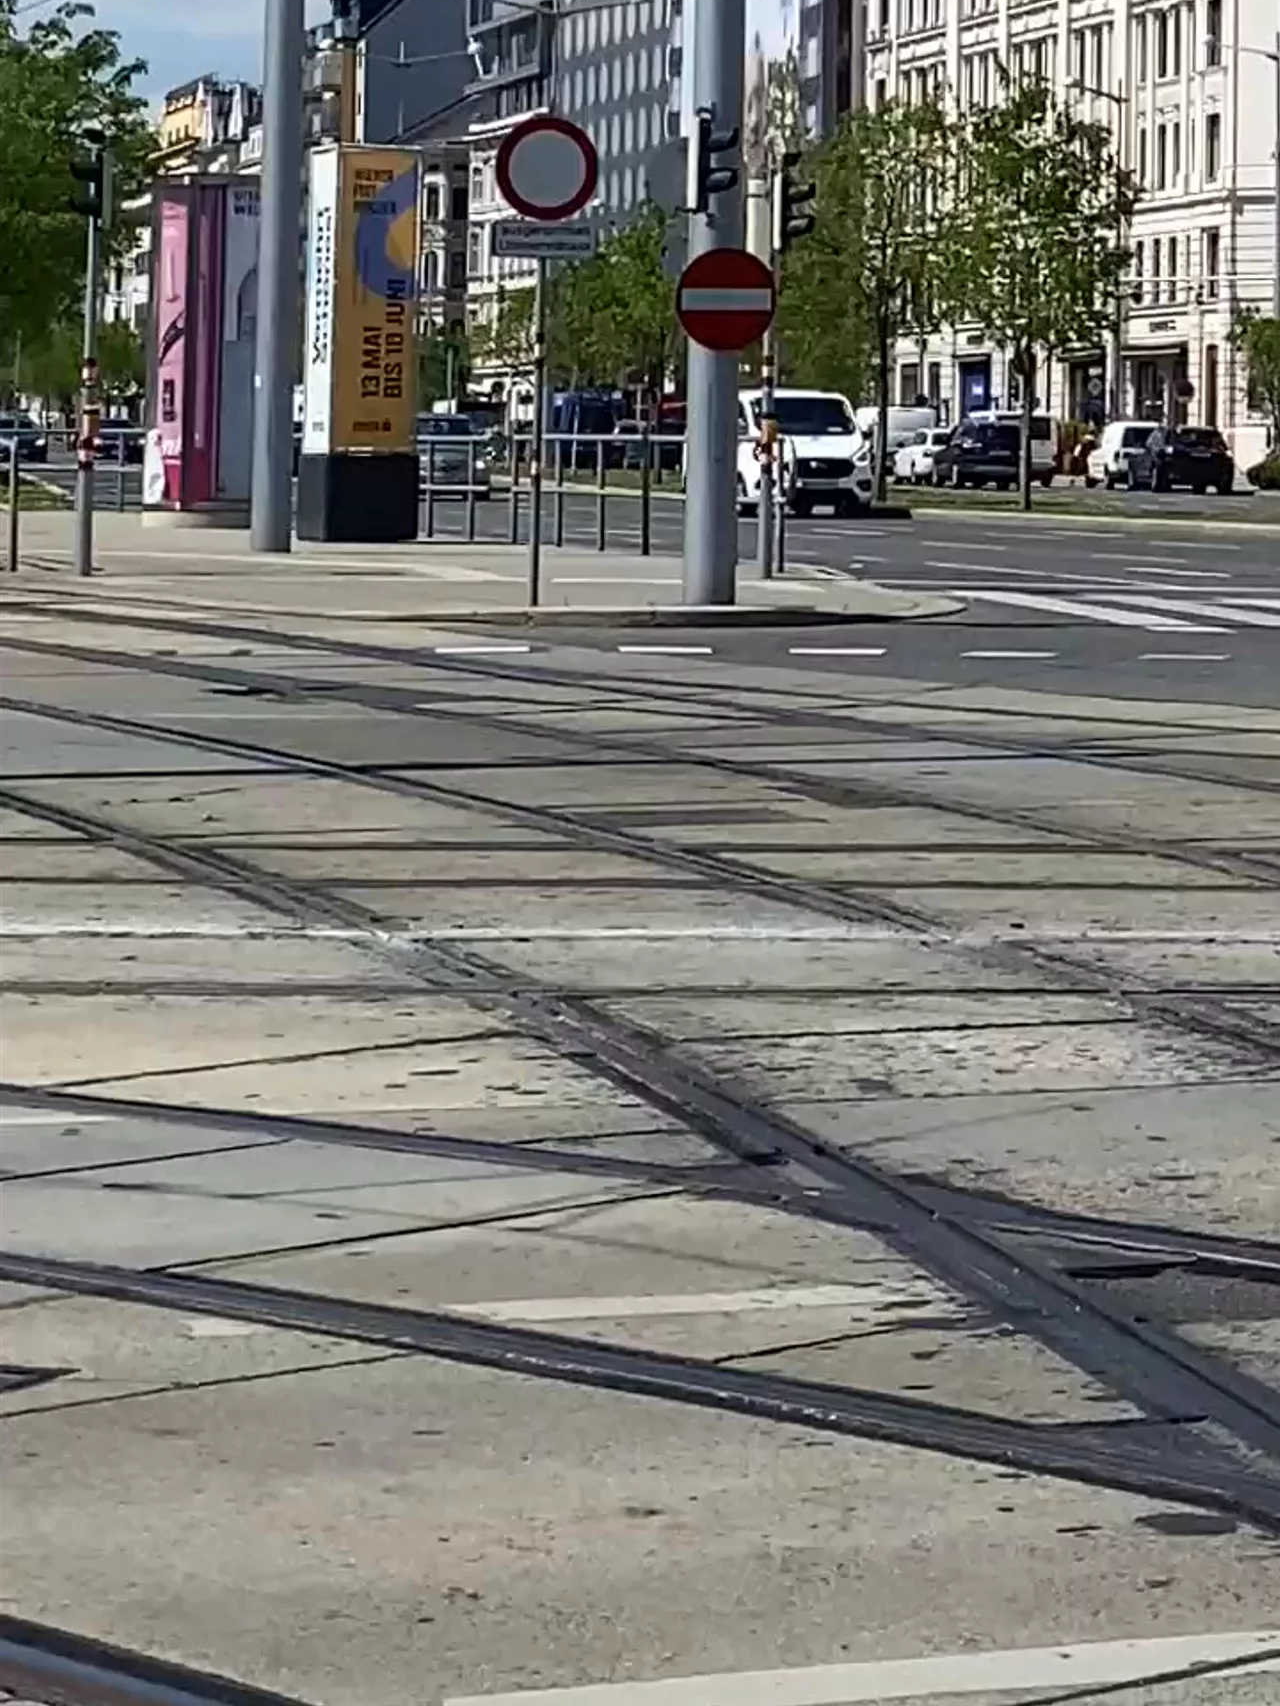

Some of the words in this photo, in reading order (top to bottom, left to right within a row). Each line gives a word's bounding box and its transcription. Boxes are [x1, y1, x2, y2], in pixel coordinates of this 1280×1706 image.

[385, 278, 407, 326] JUNI
[361, 326, 383, 369] MAI
[383, 362, 403, 398] BIS
